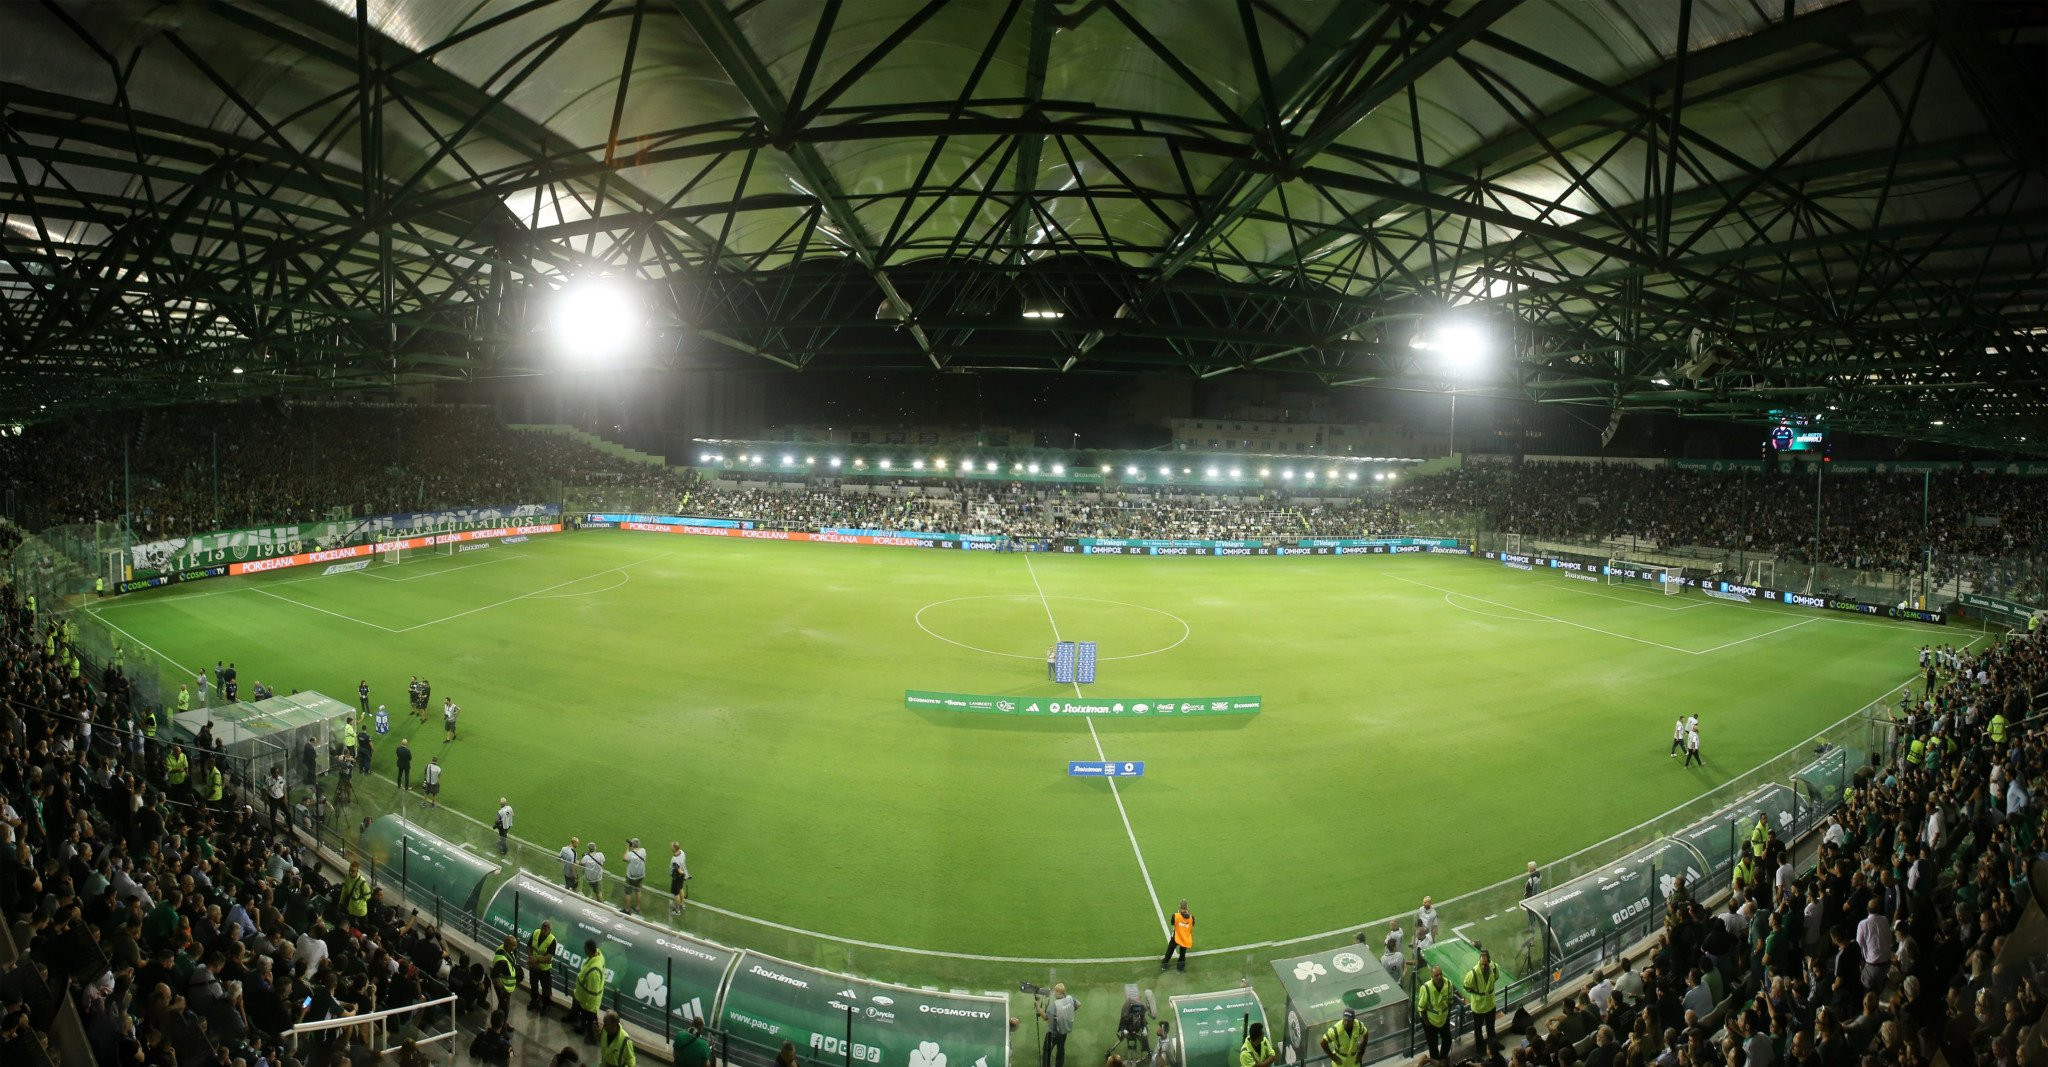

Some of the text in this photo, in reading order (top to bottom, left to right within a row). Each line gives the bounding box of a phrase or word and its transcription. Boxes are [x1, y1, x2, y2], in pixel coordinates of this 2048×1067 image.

[517, 525, 553, 535] PORCELANA
[629, 523, 671, 532] PORCELANA
[684, 526, 729, 536] PORCELANA
[472, 529, 507, 540] PORCELANA
[742, 530, 789, 540] PORCELANA
[809, 534, 858, 543] PORCELANA
[459, 542, 490, 552] Stoiximan
[970, 542, 996, 550] ΟΜΗΡΟ
[309, 548, 356, 562] PORCELANA
[242, 556, 295, 573] PORCELANA
[1565, 571, 1597, 582] Stoiximan
[494, 914, 531, 938] www.po.gr
[1565, 927, 1597, 948] www.pao.gr
[730, 1010, 780, 1034] www.pao.gr
